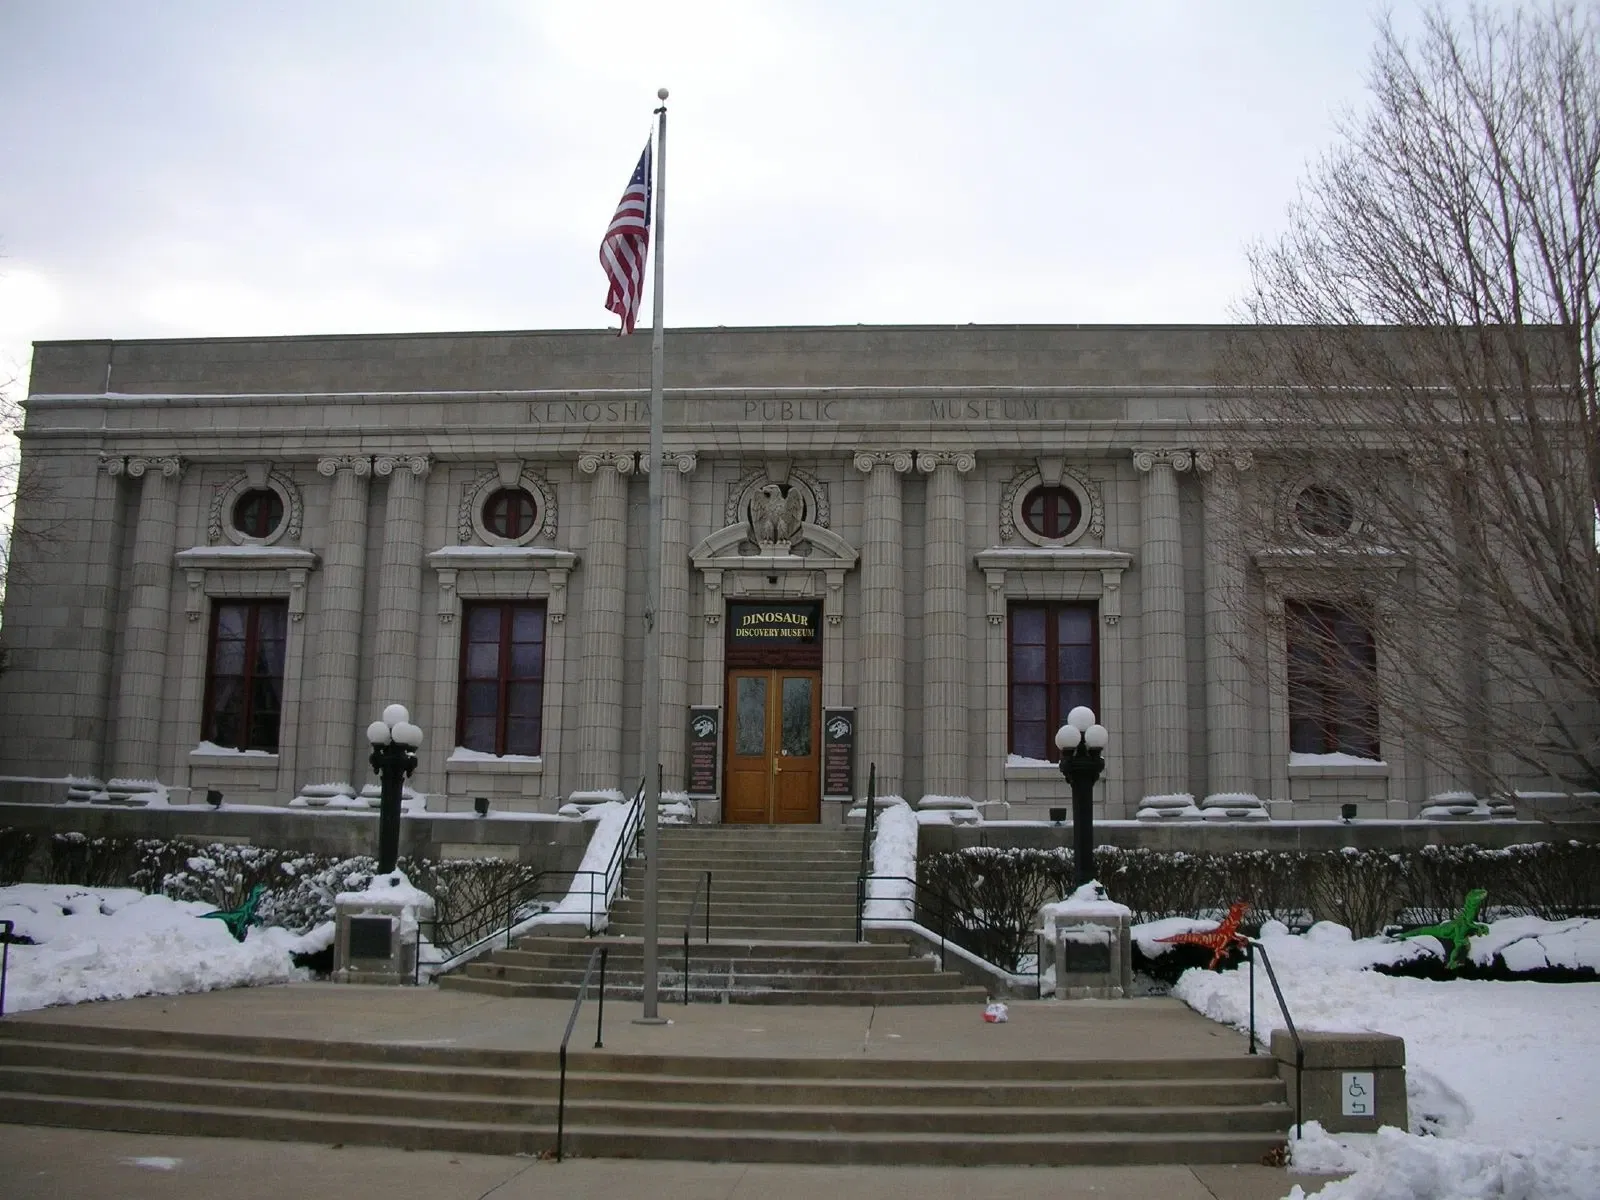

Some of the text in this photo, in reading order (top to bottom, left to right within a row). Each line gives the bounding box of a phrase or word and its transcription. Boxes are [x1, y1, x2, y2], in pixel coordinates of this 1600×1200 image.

[527, 399, 1038, 422] KENOSHA PUBLIC MUSEUM
[742, 612, 808, 626] DINOSAUR
[735, 628, 815, 637] DISCOVERY MUSEUM
